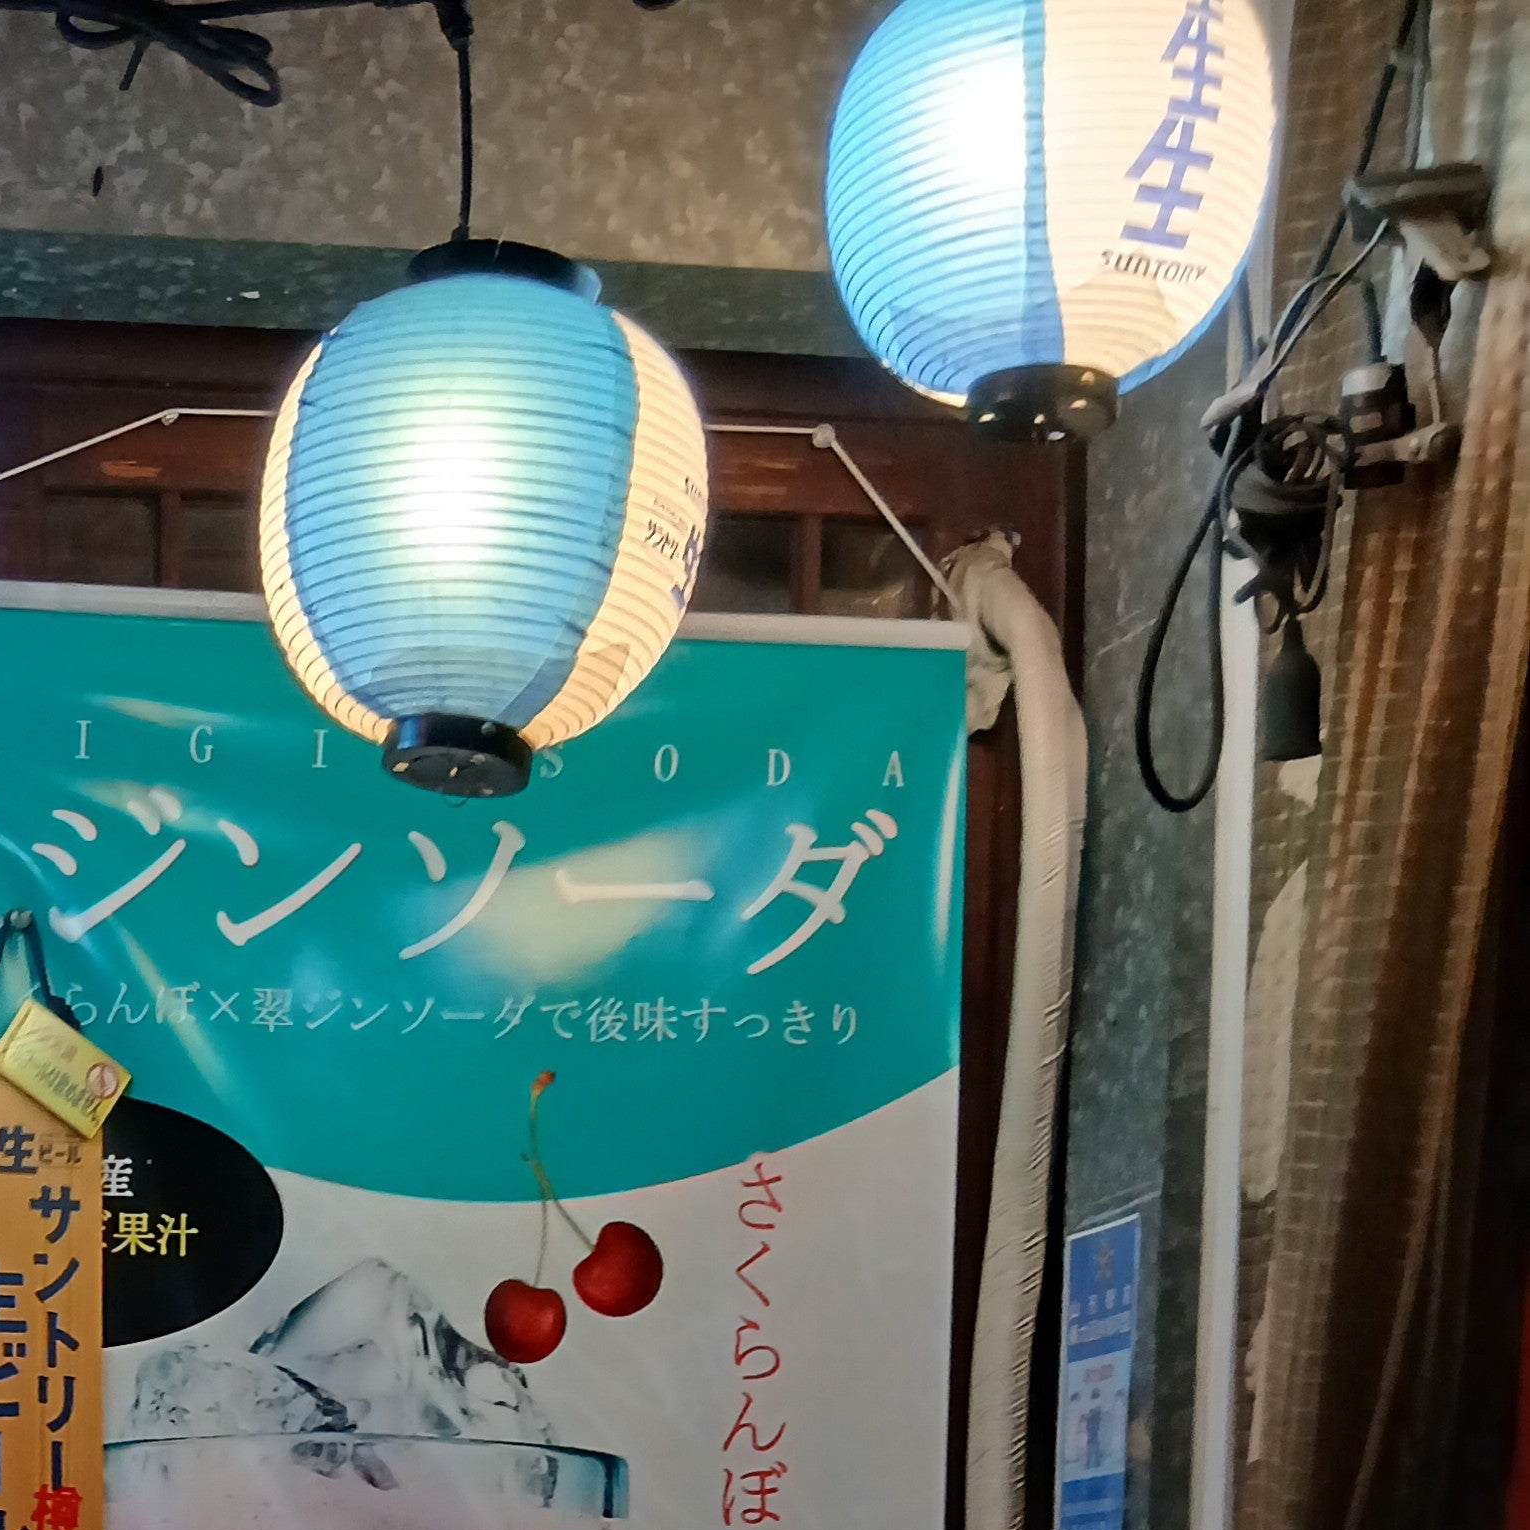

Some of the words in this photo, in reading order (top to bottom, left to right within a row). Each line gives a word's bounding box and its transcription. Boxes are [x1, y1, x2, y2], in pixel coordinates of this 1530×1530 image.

[1101, 249, 1207, 284] SUNTORY
[29, 1185, 82, 1491] サントリー
